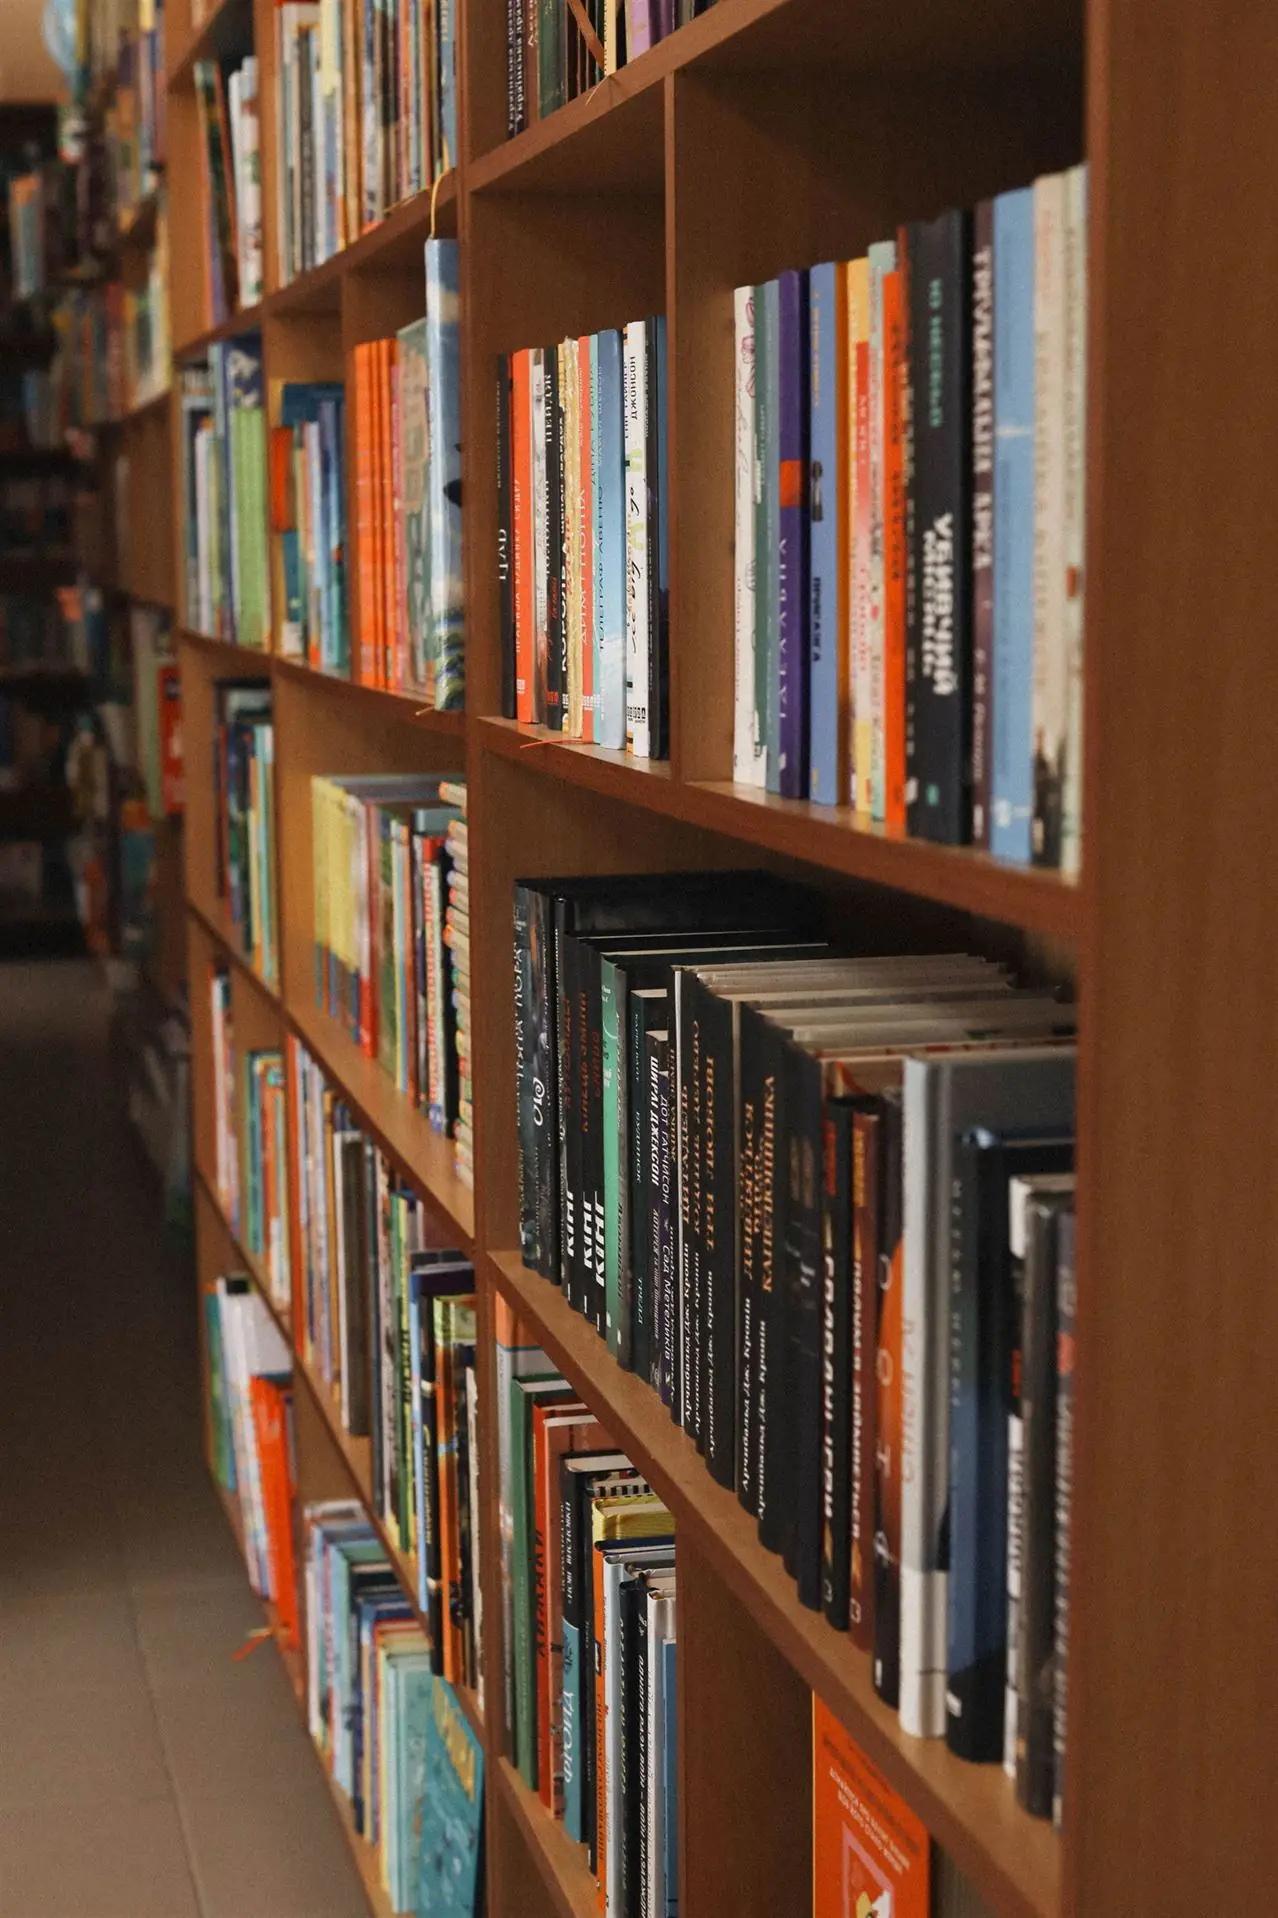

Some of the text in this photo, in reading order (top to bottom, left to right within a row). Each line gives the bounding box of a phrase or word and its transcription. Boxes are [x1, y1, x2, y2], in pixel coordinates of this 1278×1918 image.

[498, 529, 509, 580] ЦАР
[651, 1110, 660, 1187] ДЖЕКСОН
[661, 1094, 670, 1205] ДОТ ГАТЧИСОН
[705, 1055, 714, 1251] ТРИ ЛЮБОВІ
[566, 1191, 574, 1257] КІНГ
[583, 1192, 592, 1269] КІНГ
[595, 1191, 605, 1287] КІНГ
[683, 1242, 691, 1298] Кронін
[706, 1271, 714, 1330] Кронін
[743, 1297, 751, 1359] Кронін
[758, 1319, 768, 1383] Кронін
[684, 1337, 693, 1422] Арчибальд
[707, 1369, 715, 1459] Арчибальд
[823, 1254, 835, 1518] ГОЛОДНІ ІГРИ
[743, 1399, 751, 1492] Арчибальд
[758, 1424, 767, 1521] Арчибальд
